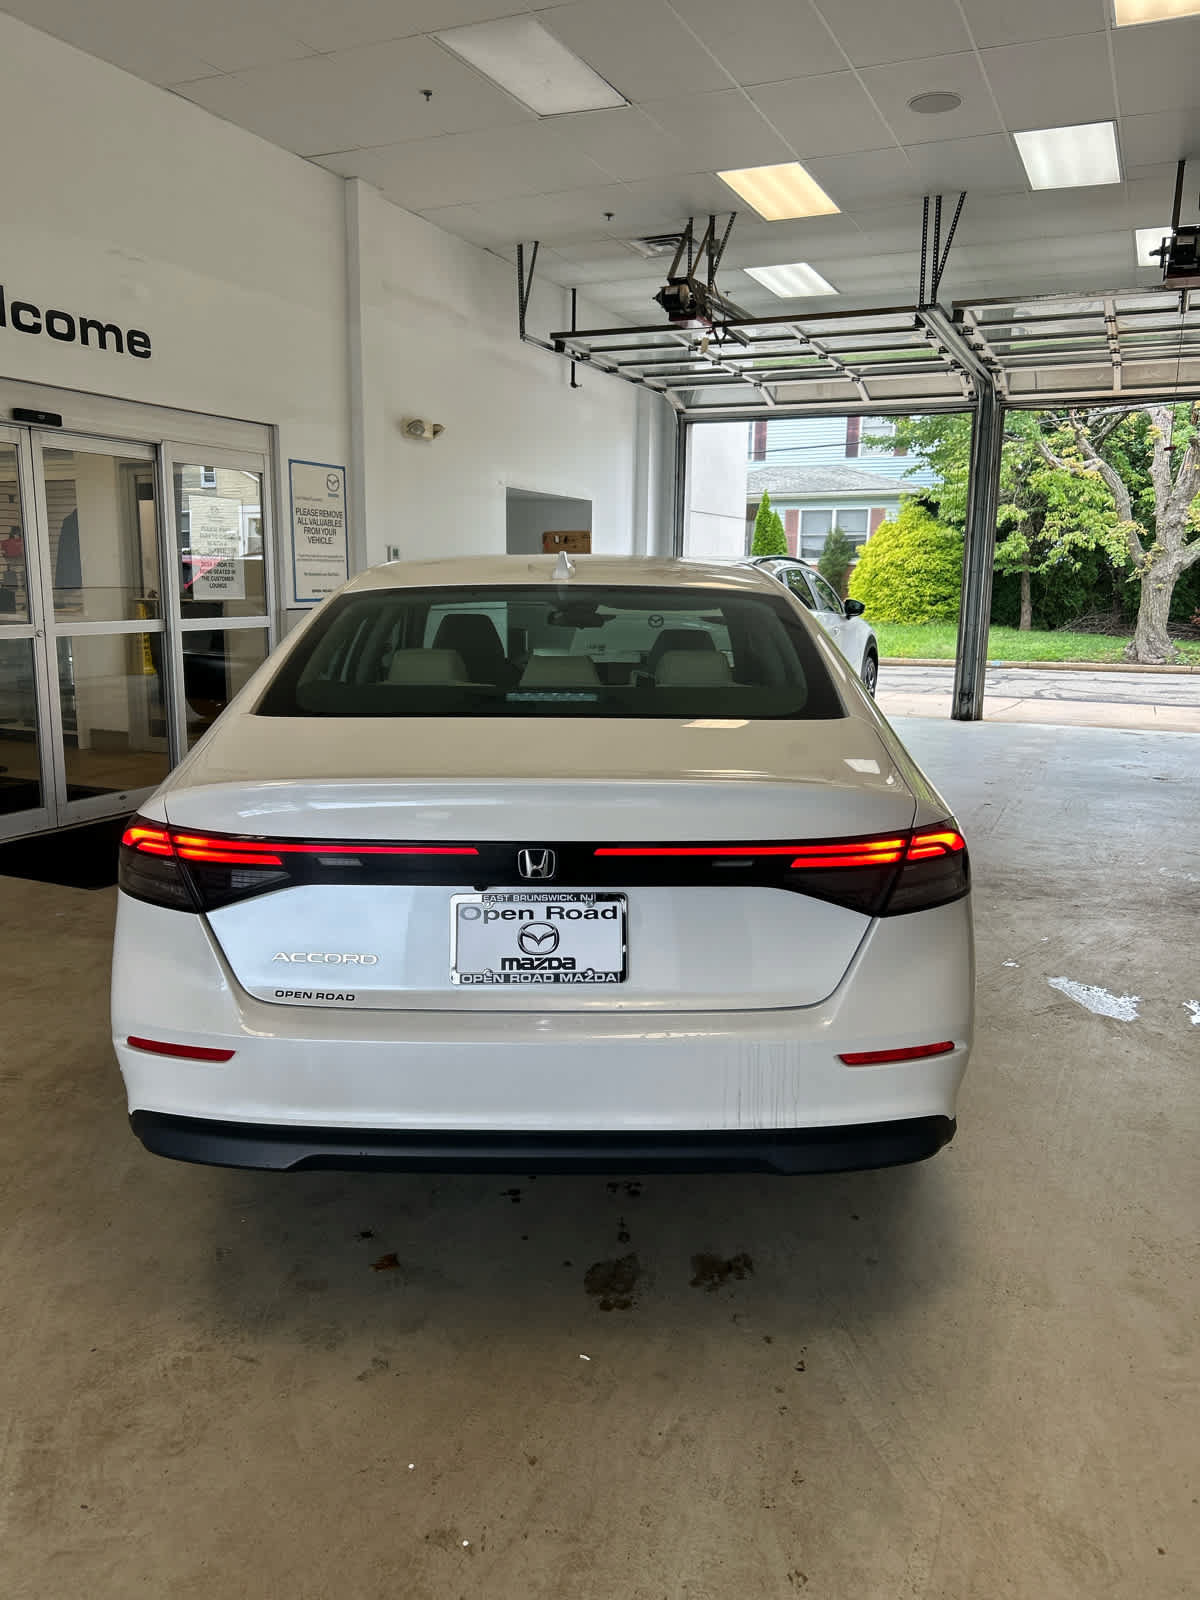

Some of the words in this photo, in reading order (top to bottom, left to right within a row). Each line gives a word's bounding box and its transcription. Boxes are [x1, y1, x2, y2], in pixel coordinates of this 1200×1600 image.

[295, 507, 319, 517] PLEASE
[319, 509, 343, 519] REMOVE
[297, 517, 309, 526] ALL
[309, 518, 344, 528] VALUABLES
[303, 526, 320, 535] FROM
[320, 528, 337, 537] YOUR
[460, 907, 534, 924] Open
[546, 906, 617, 920] Road
[272, 952, 379, 965] ACCORD
[501, 957, 576, 970] mazda
[461, 974, 505, 984] OPEN
[510, 974, 554, 983] ROAD
[275, 990, 313, 999] OPEN
[315, 992, 355, 1001] ROAD
